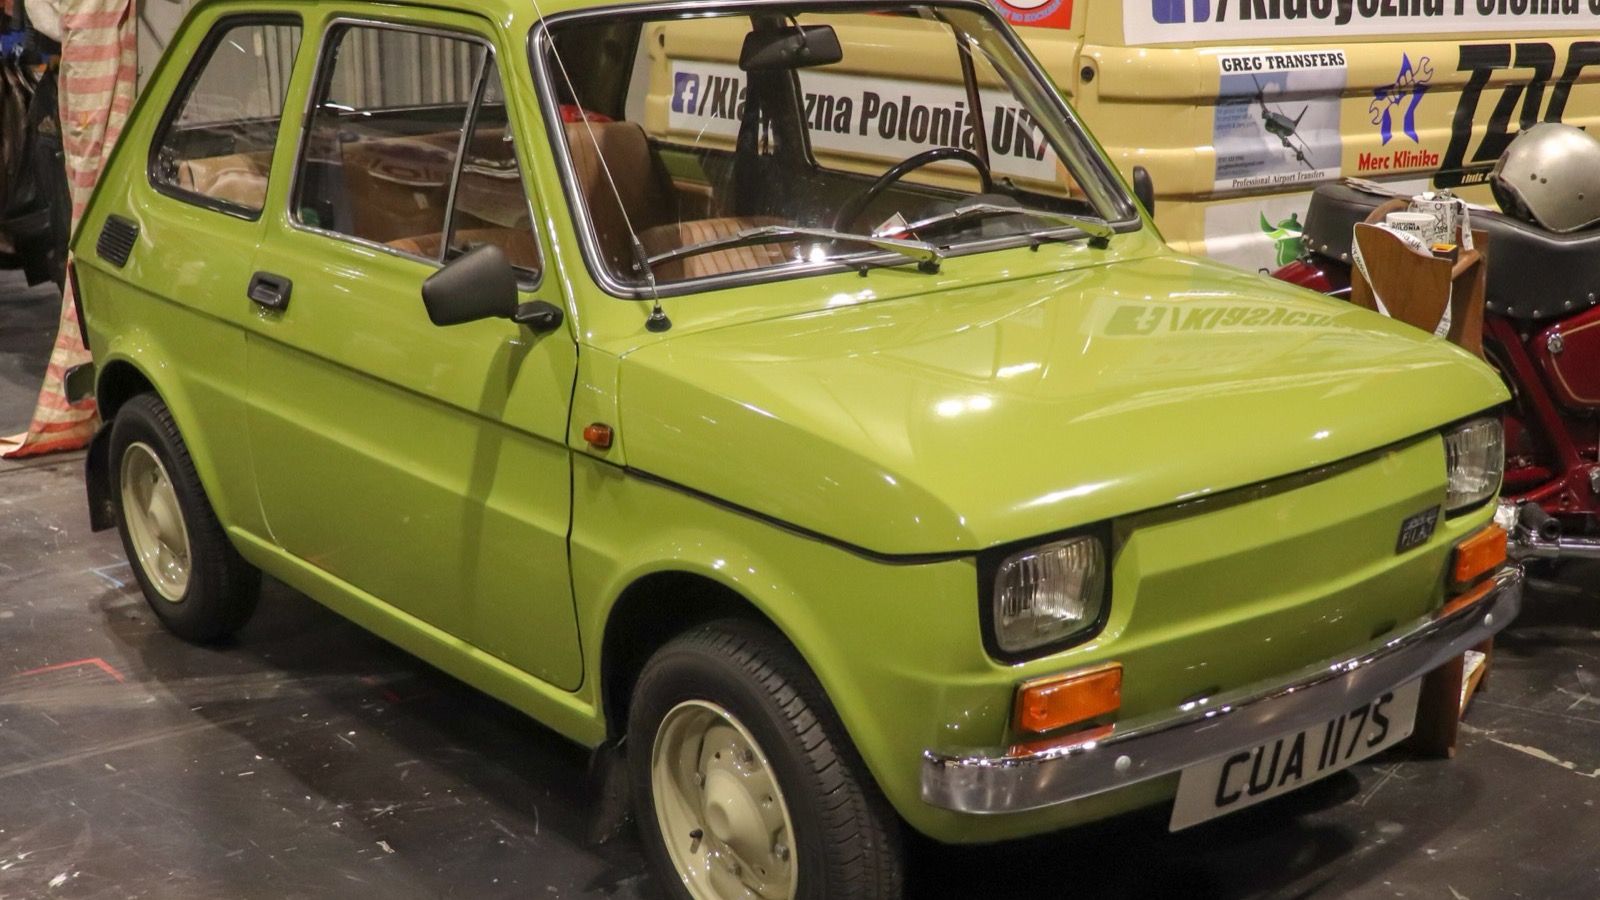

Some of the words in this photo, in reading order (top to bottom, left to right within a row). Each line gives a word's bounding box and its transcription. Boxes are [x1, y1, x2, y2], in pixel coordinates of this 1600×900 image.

[1221, 56, 1263, 72] GREG
[1265, 52, 1345, 70] TRANSFERS
[1358, 152, 1390, 170] Merc
[1393, 149, 1439, 169] Klinika
[1232, 175, 1270, 188] Professional
[1273, 173, 1296, 185] Airport
[1297, 170, 1325, 182] Transfers
[1214, 731, 1306, 808] CUA
[1317, 691, 1394, 771] 117S
